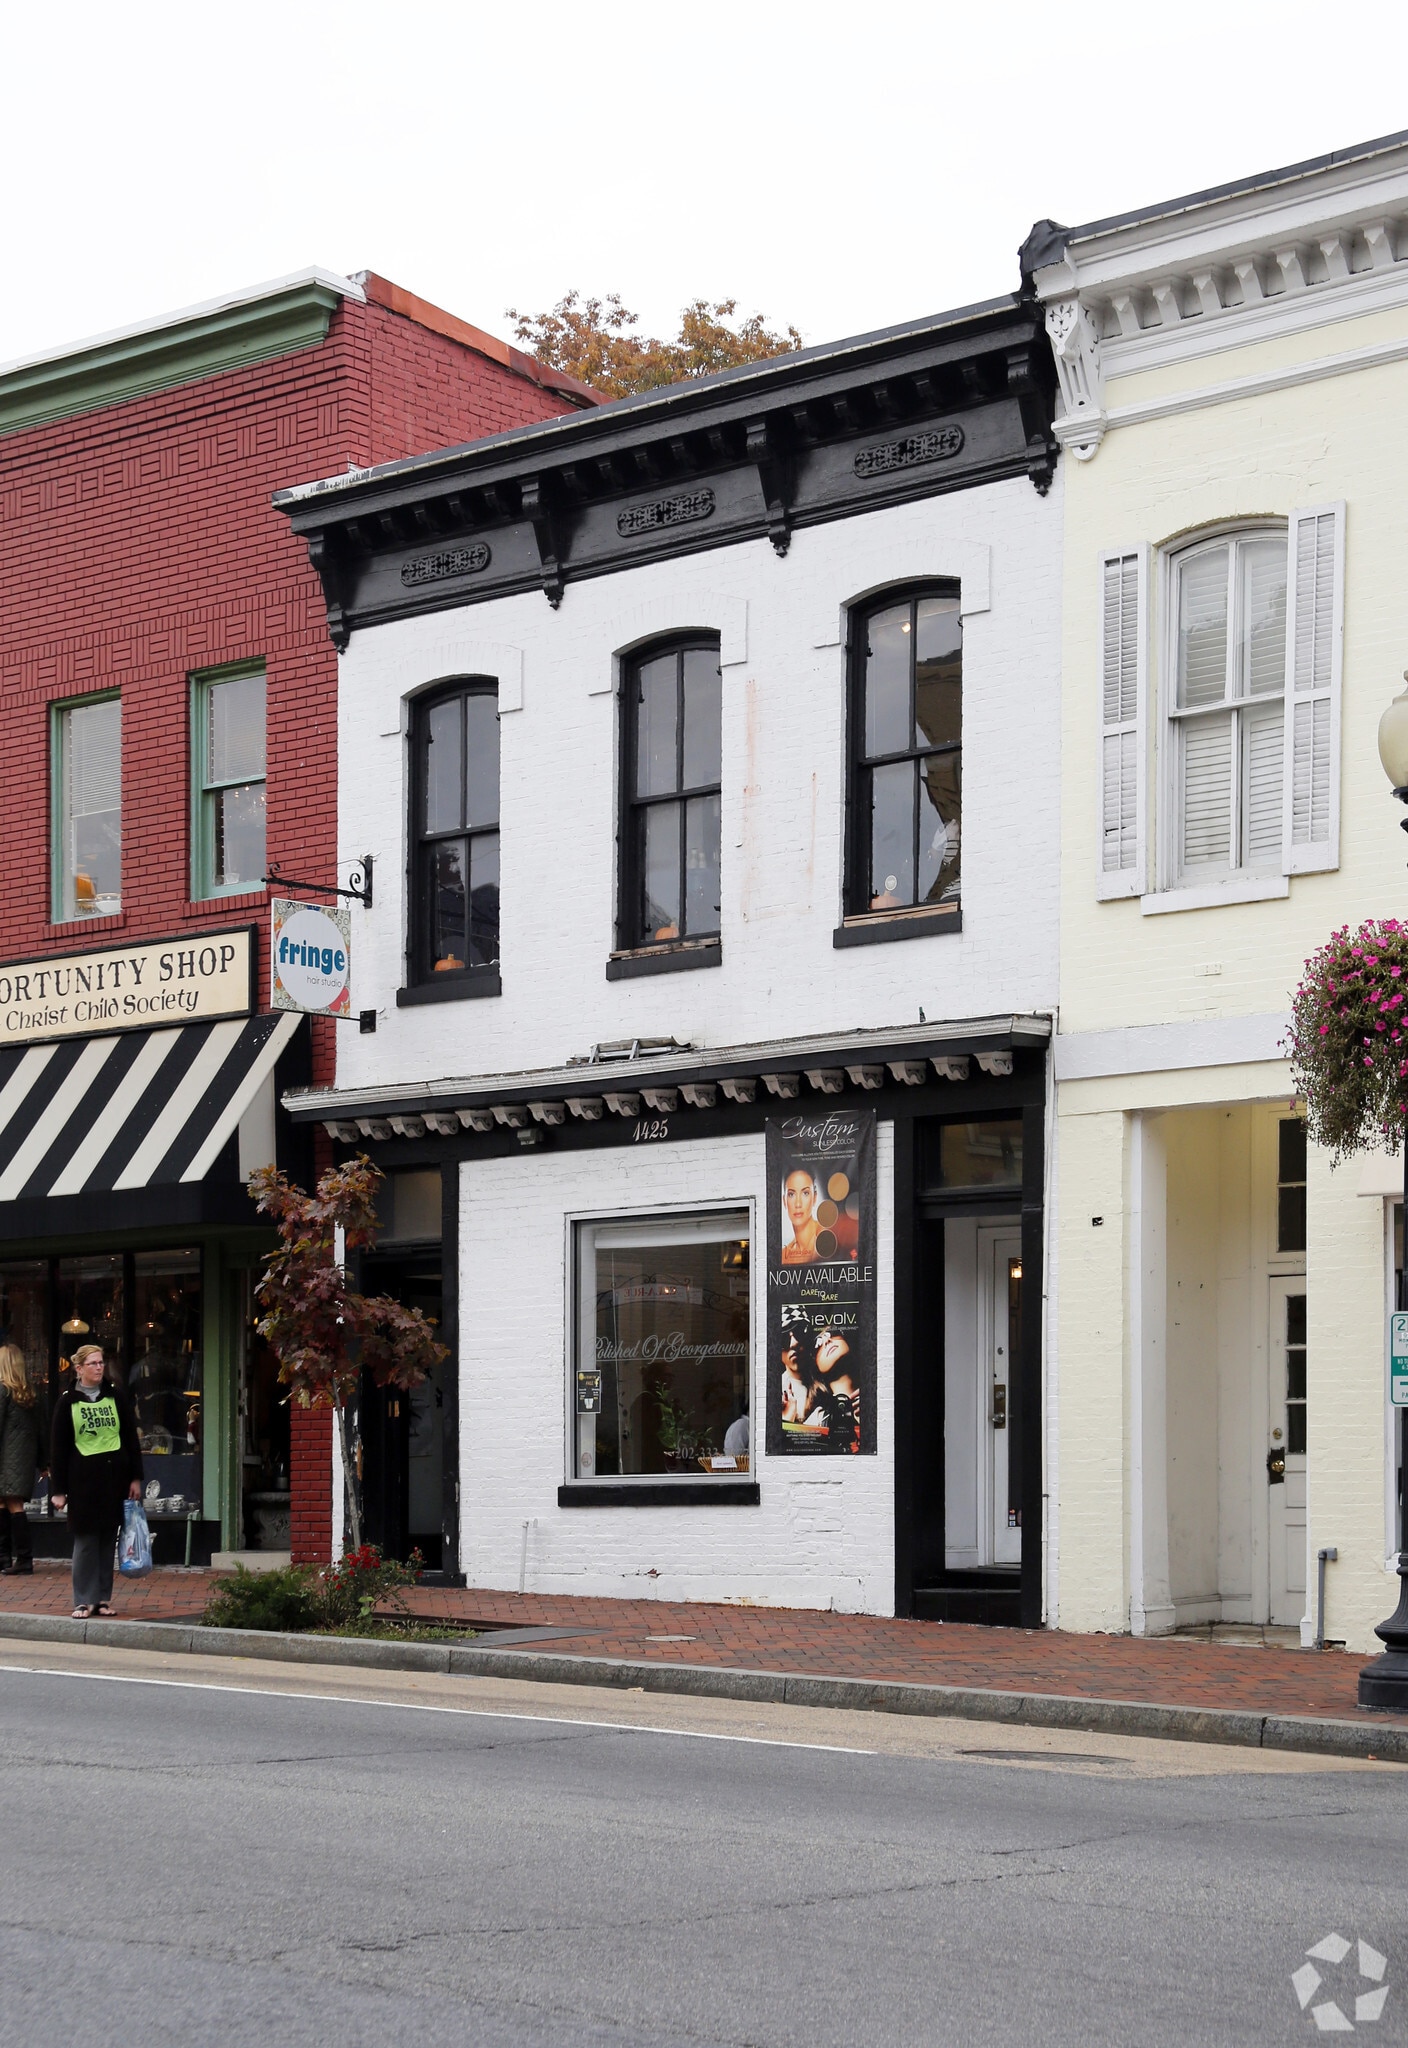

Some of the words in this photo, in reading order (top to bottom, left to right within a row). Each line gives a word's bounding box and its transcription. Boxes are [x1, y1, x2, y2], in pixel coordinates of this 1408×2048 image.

[279, 936, 345, 975] fringe
[0, 957, 147, 1004] ORTUNITY
[159, 945, 235, 981] SHOP
[306, 975, 320, 985] hair
[321, 978, 342, 987] studio
[75, 997, 119, 1022] Child
[123, 989, 199, 1015] Society
[632, 1118, 668, 1142] 1425
[781, 1110, 859, 1152] Custom
[769, 1269, 801, 1286] NOW
[805, 1266, 873, 1285] AVAILABLE
[801, 1288, 818, 1297] DARE
[817, 1290, 826, 1298] TO
[587, 1336, 640, 1360] Polished
[664, 1331, 745, 1366] Georgetown
